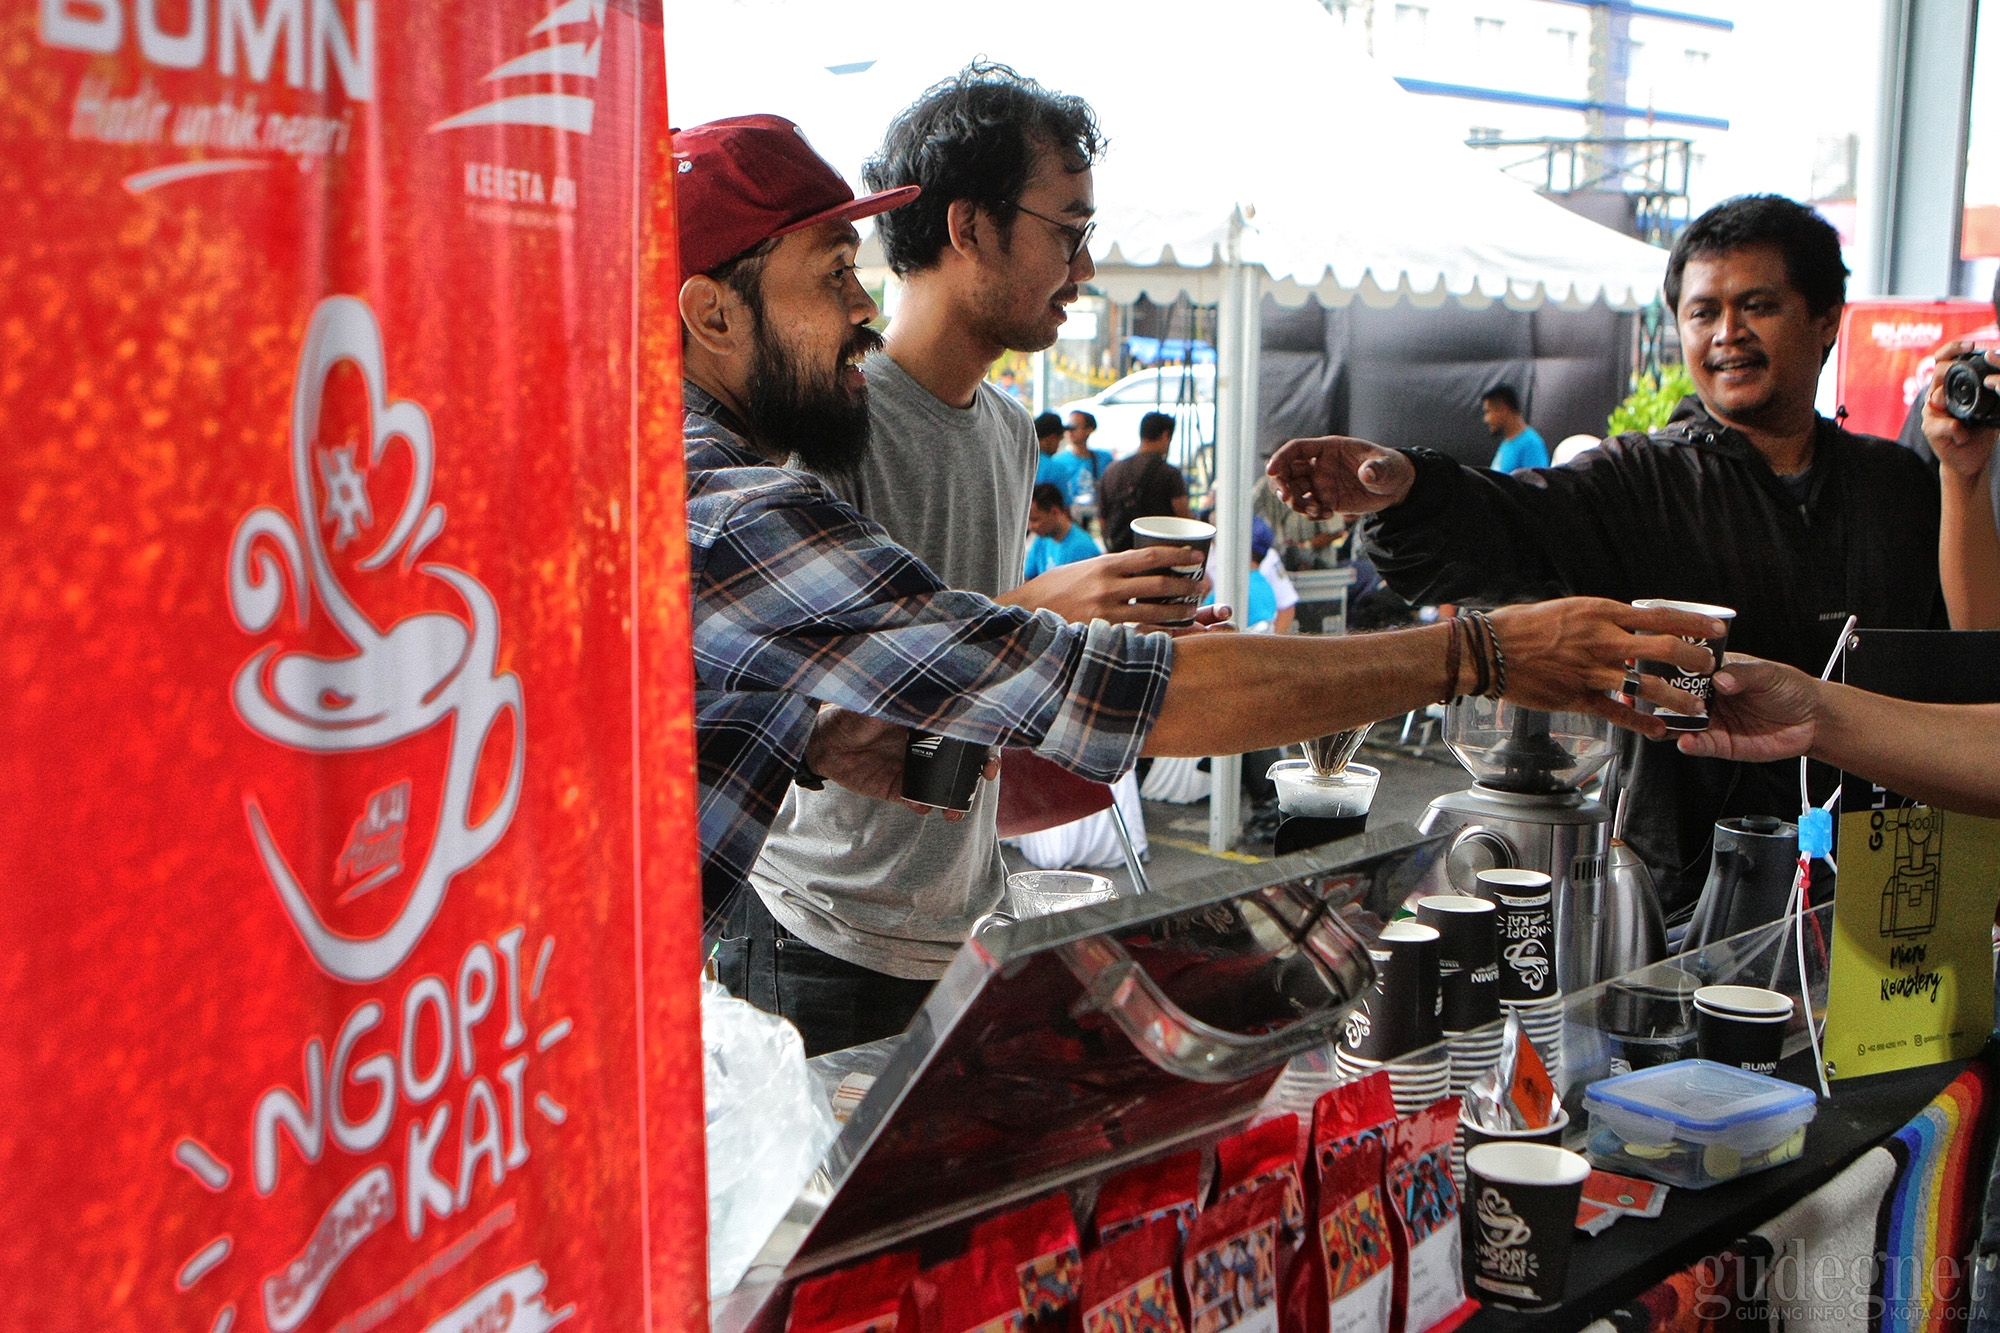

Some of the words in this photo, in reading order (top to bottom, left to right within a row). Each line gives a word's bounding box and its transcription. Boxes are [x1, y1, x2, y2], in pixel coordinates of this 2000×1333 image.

[1670, 677, 1711, 689] NGOPI
[1507, 915, 1530, 927] KAI
[1506, 925, 1547, 939] NGOPI
[1889, 944, 1928, 969] Micro
[1880, 966, 1943, 1003] Roastery
[253, 924, 526, 1196] NGOPI
[1741, 1061, 1778, 1072] BUMN
[407, 1055, 531, 1240] KAI
[1479, 1243, 1527, 1263] NGOPI
